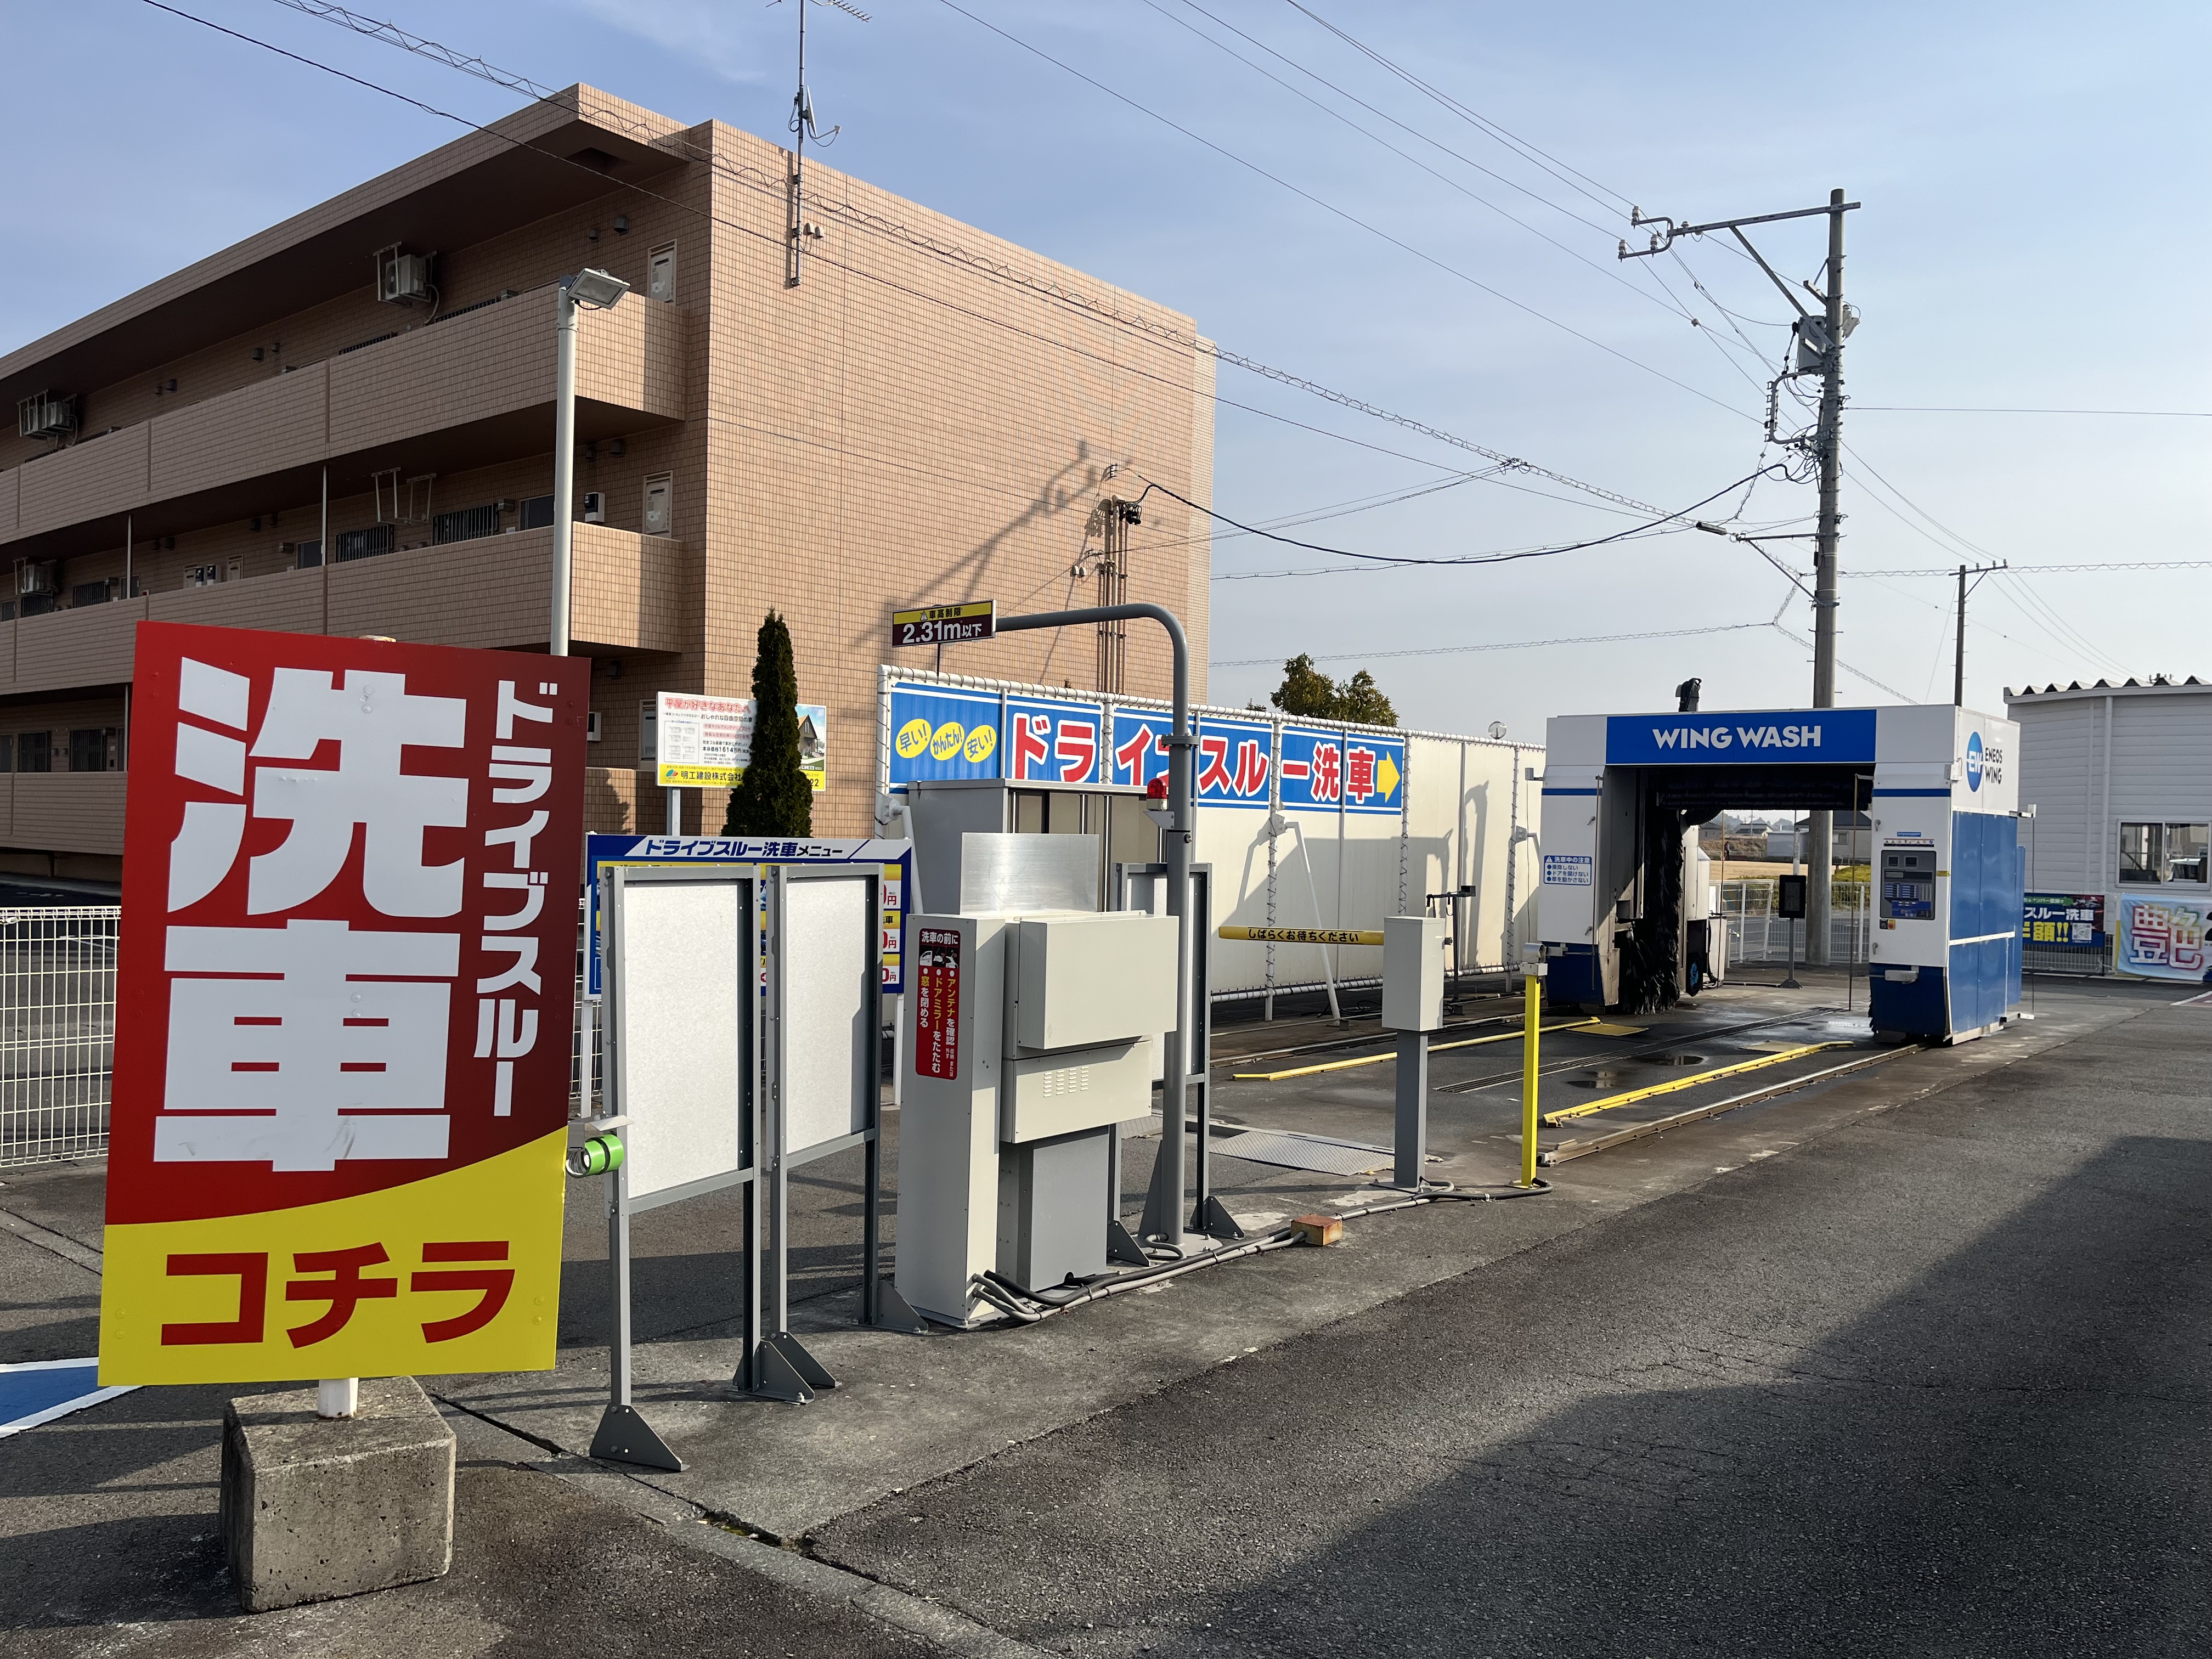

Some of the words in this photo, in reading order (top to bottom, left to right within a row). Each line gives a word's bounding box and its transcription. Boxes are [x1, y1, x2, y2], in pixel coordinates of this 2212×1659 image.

[929, 607, 962, 619] 車高制限
[902, 620, 982, 644] 2.31m以下
[664, 697, 751, 714] 平屋が好きなあなたへ
[899, 723, 929, 753] 早い!
[967, 728, 994, 758] 安い!
[1652, 726, 1734, 749] WING
[1736, 725, 1822, 748] WASH
[1985, 747, 2003, 764] ENEOS
[681, 771, 742, 781] 明工建設株式会社
[1985, 765, 2002, 784] WING
[645, 839, 843, 857] ドライブスルー洗車メニュー
[473, 679, 560, 1118] ドライブスルー
[153, 656, 470, 1173] 洗車
[921, 930, 959, 945] 洗車の前に
[1248, 928, 1359, 943] しばらくお待ちください
[919, 975, 930, 1028] 窓を閉める
[945, 978, 956, 1046] アンテナを確認
[932, 977, 944, 1074] ドアミラーをたたむ
[160, 1240, 516, 1350] コチラ
